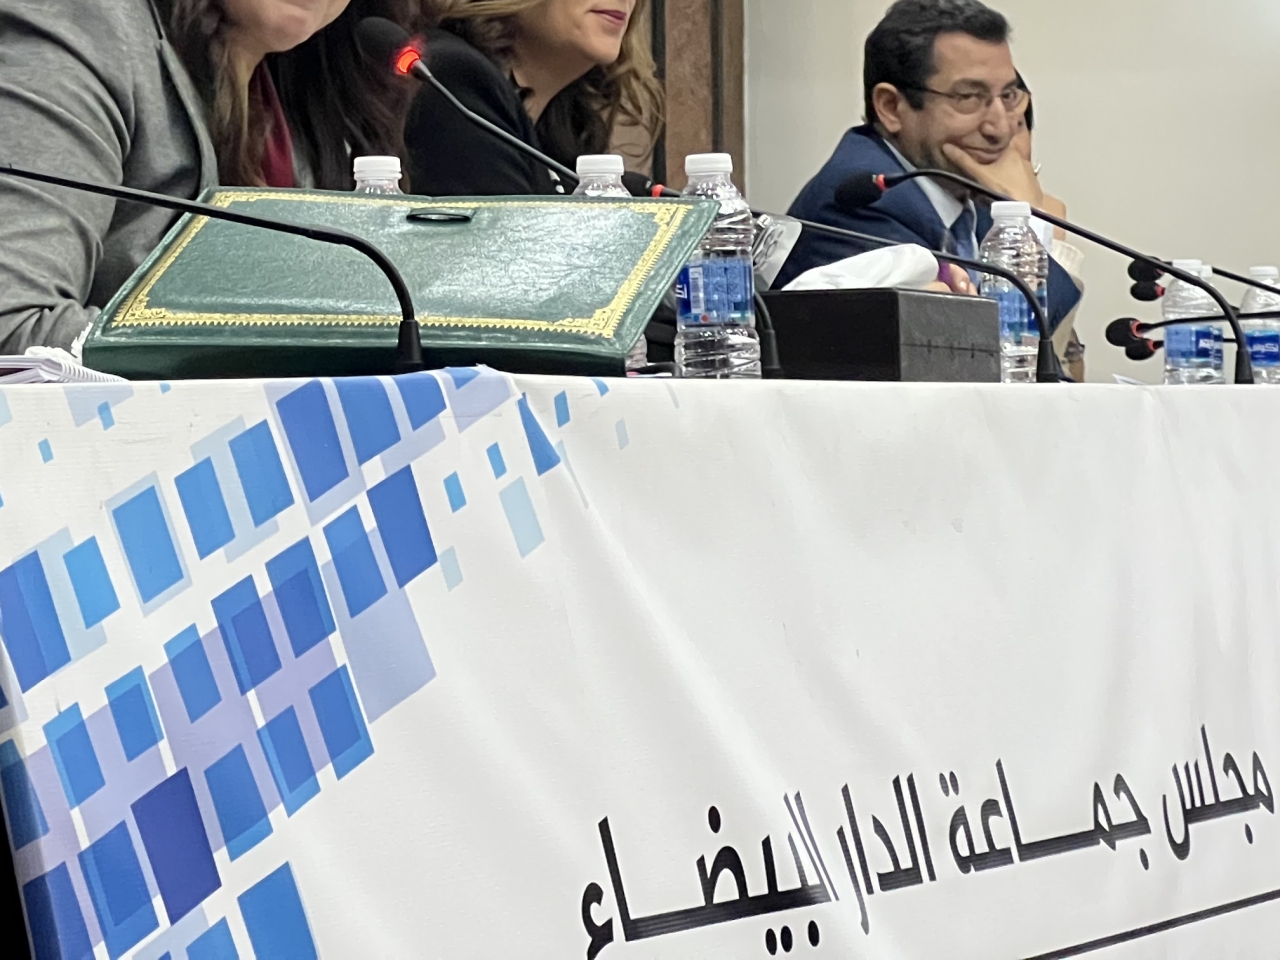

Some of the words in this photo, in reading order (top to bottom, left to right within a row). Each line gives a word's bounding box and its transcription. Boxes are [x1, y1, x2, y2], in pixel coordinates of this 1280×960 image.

[836, 772, 937, 936] الدار
[939, 757, 1152, 874] جماعة
[1163, 723, 1275, 860] مجلس
[581, 790, 840, 960] البيضاء
